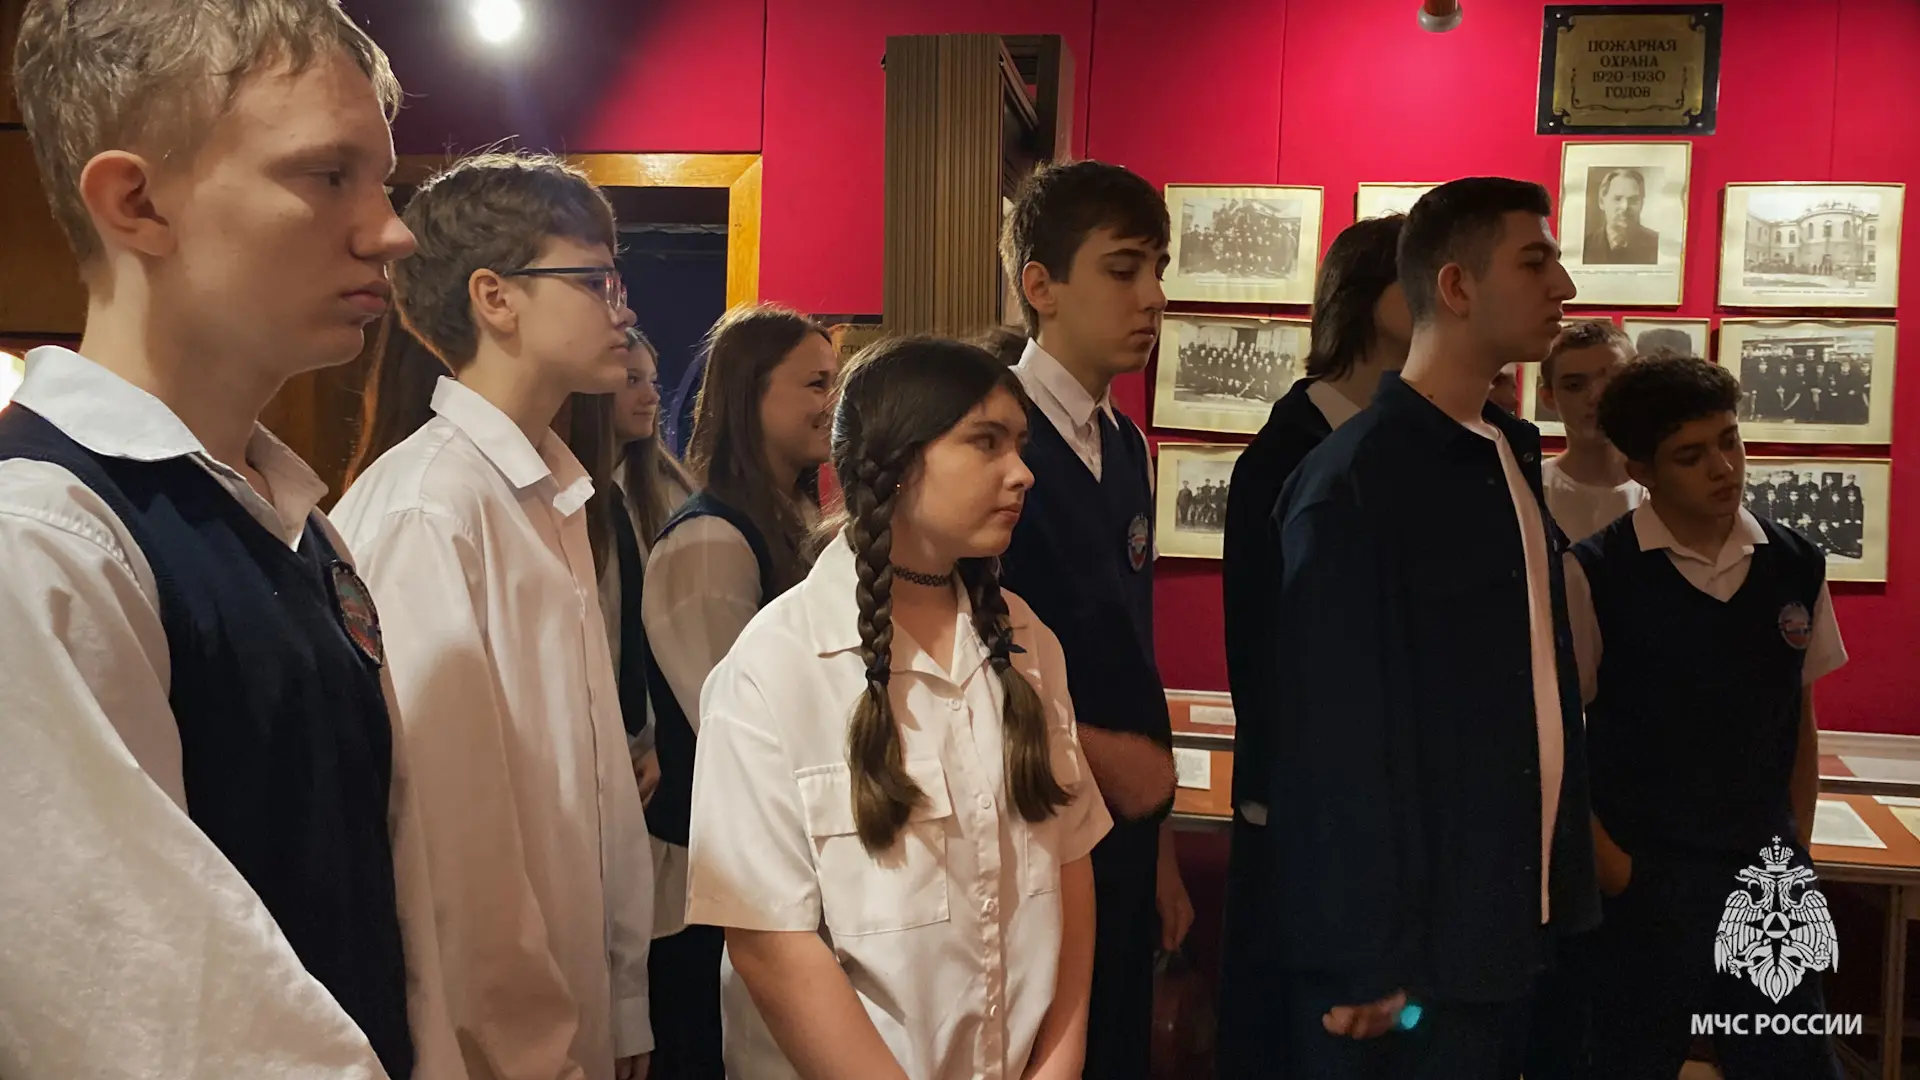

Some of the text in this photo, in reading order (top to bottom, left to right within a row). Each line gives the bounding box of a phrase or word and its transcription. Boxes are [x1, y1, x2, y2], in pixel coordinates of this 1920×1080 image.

[1588, 39, 1677, 53] ПОЖАРНАЯ
[1600, 55, 1659, 68] ОХРАНА
[1605, 86, 1651, 99] ГОДОВ
